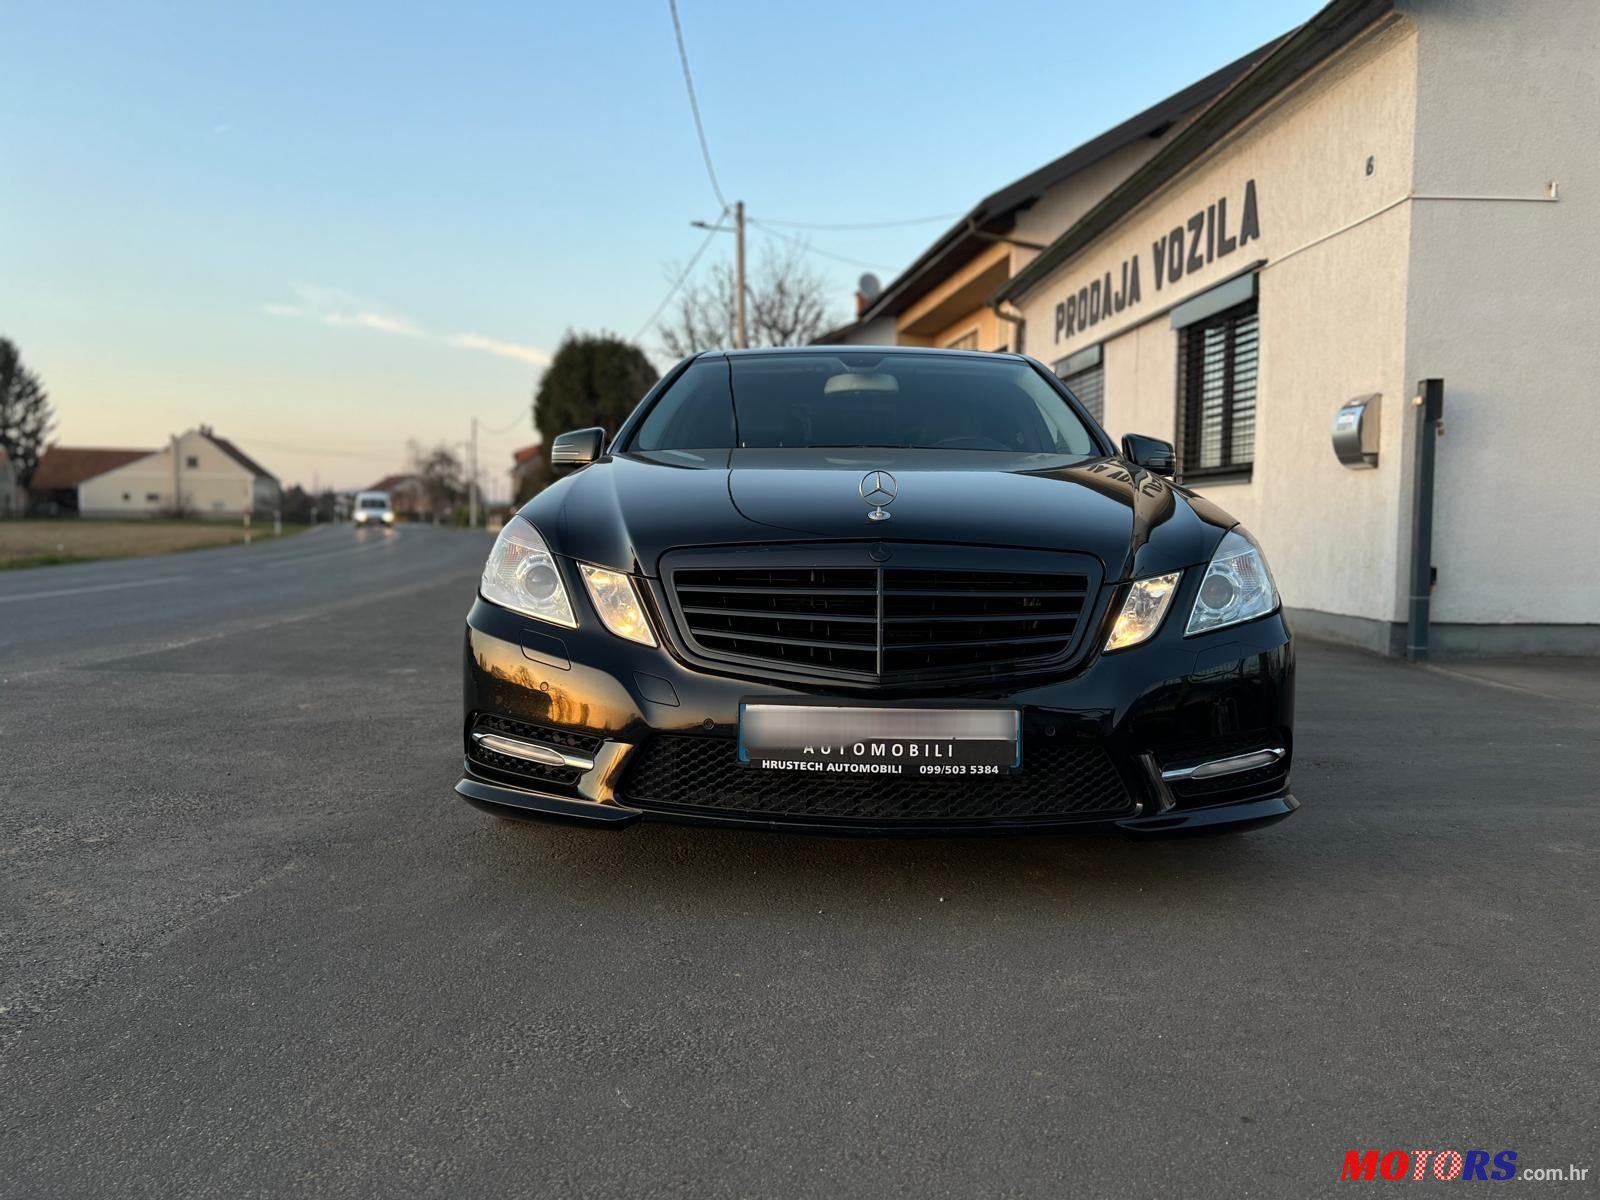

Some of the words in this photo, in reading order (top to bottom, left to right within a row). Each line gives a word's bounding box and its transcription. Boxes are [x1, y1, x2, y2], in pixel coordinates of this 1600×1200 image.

[1365, 155, 1375, 176] 6
[1055, 254, 1141, 345] PRODAJA
[1152, 178, 1261, 291] VOZILA
[762, 759, 823, 771] HRUSTECH
[826, 763, 902, 774] AUTOMOBILI
[919, 764, 966, 775] 099/503
[970, 765, 999, 775] 5384
